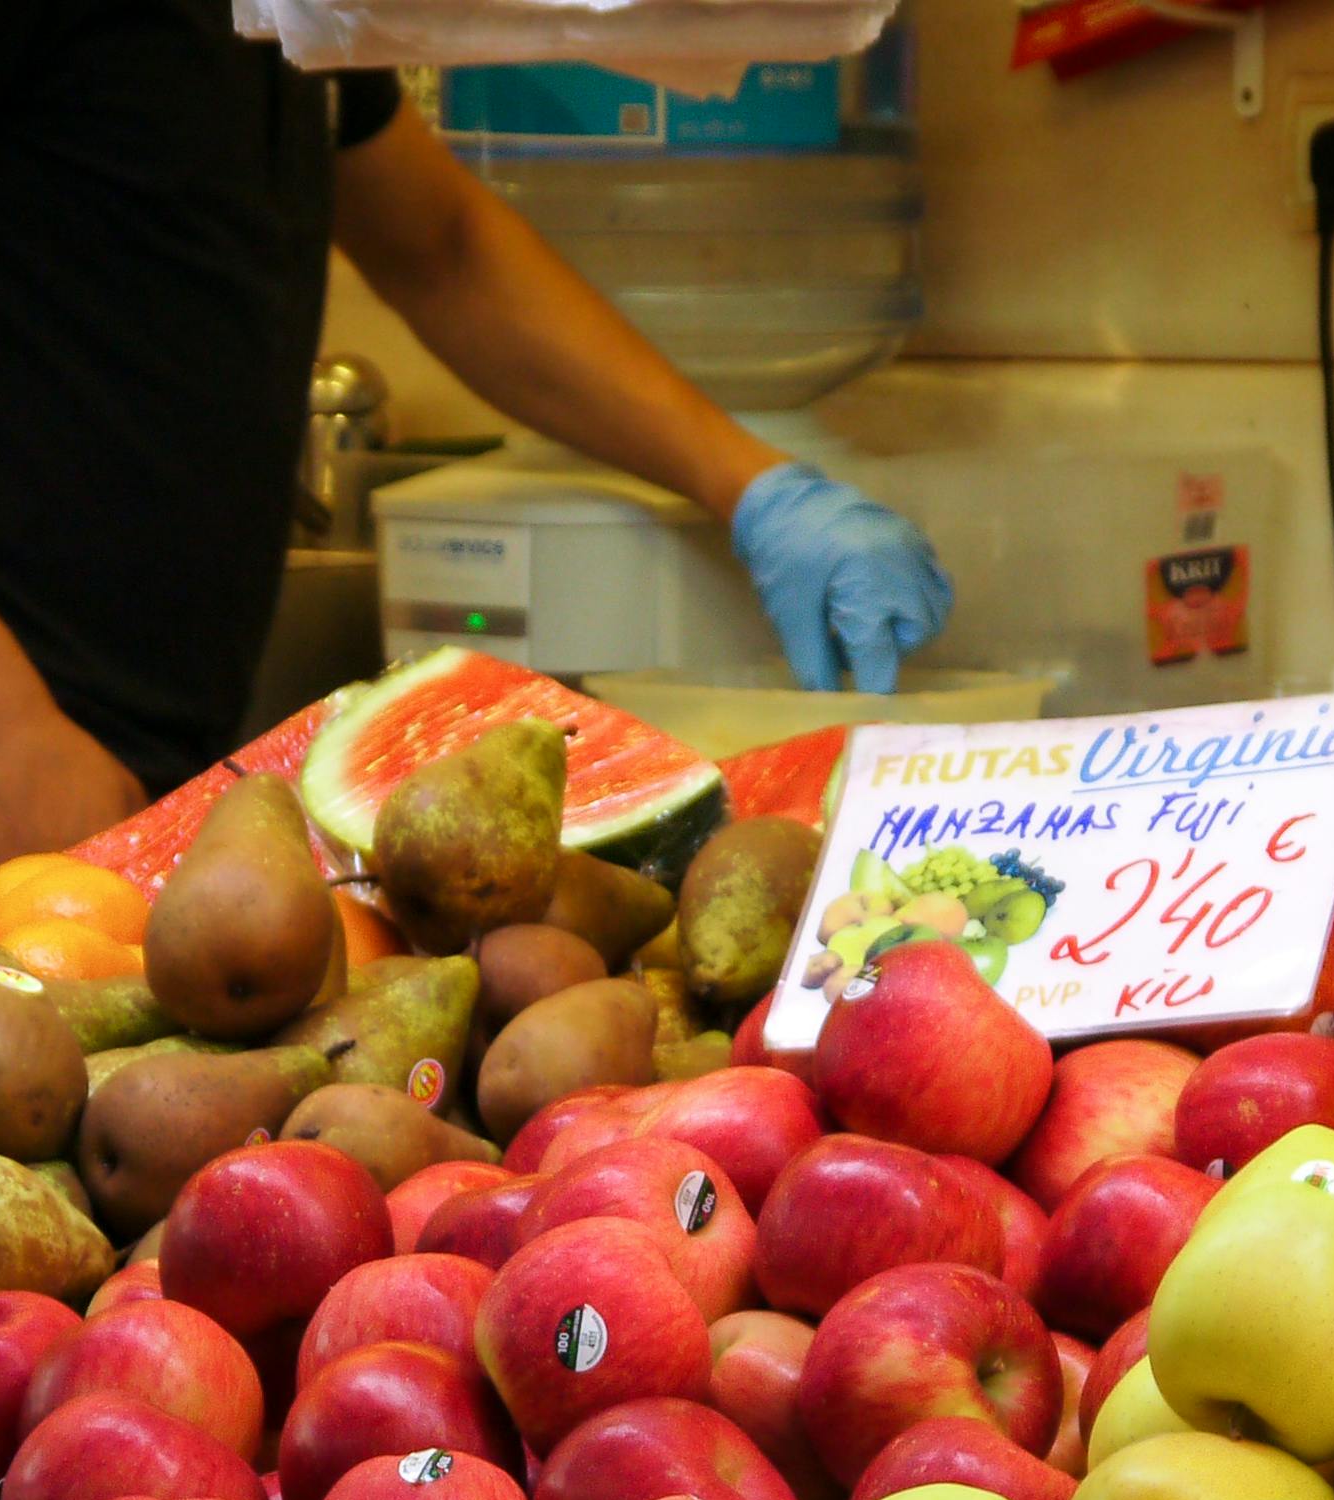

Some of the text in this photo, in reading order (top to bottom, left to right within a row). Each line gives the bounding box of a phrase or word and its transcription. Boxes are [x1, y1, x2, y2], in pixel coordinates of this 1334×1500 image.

[869, 742, 1075, 787] FRUTAS
[1266, 813, 1315, 863] €
[1014, 981, 1083, 1010] PVP
